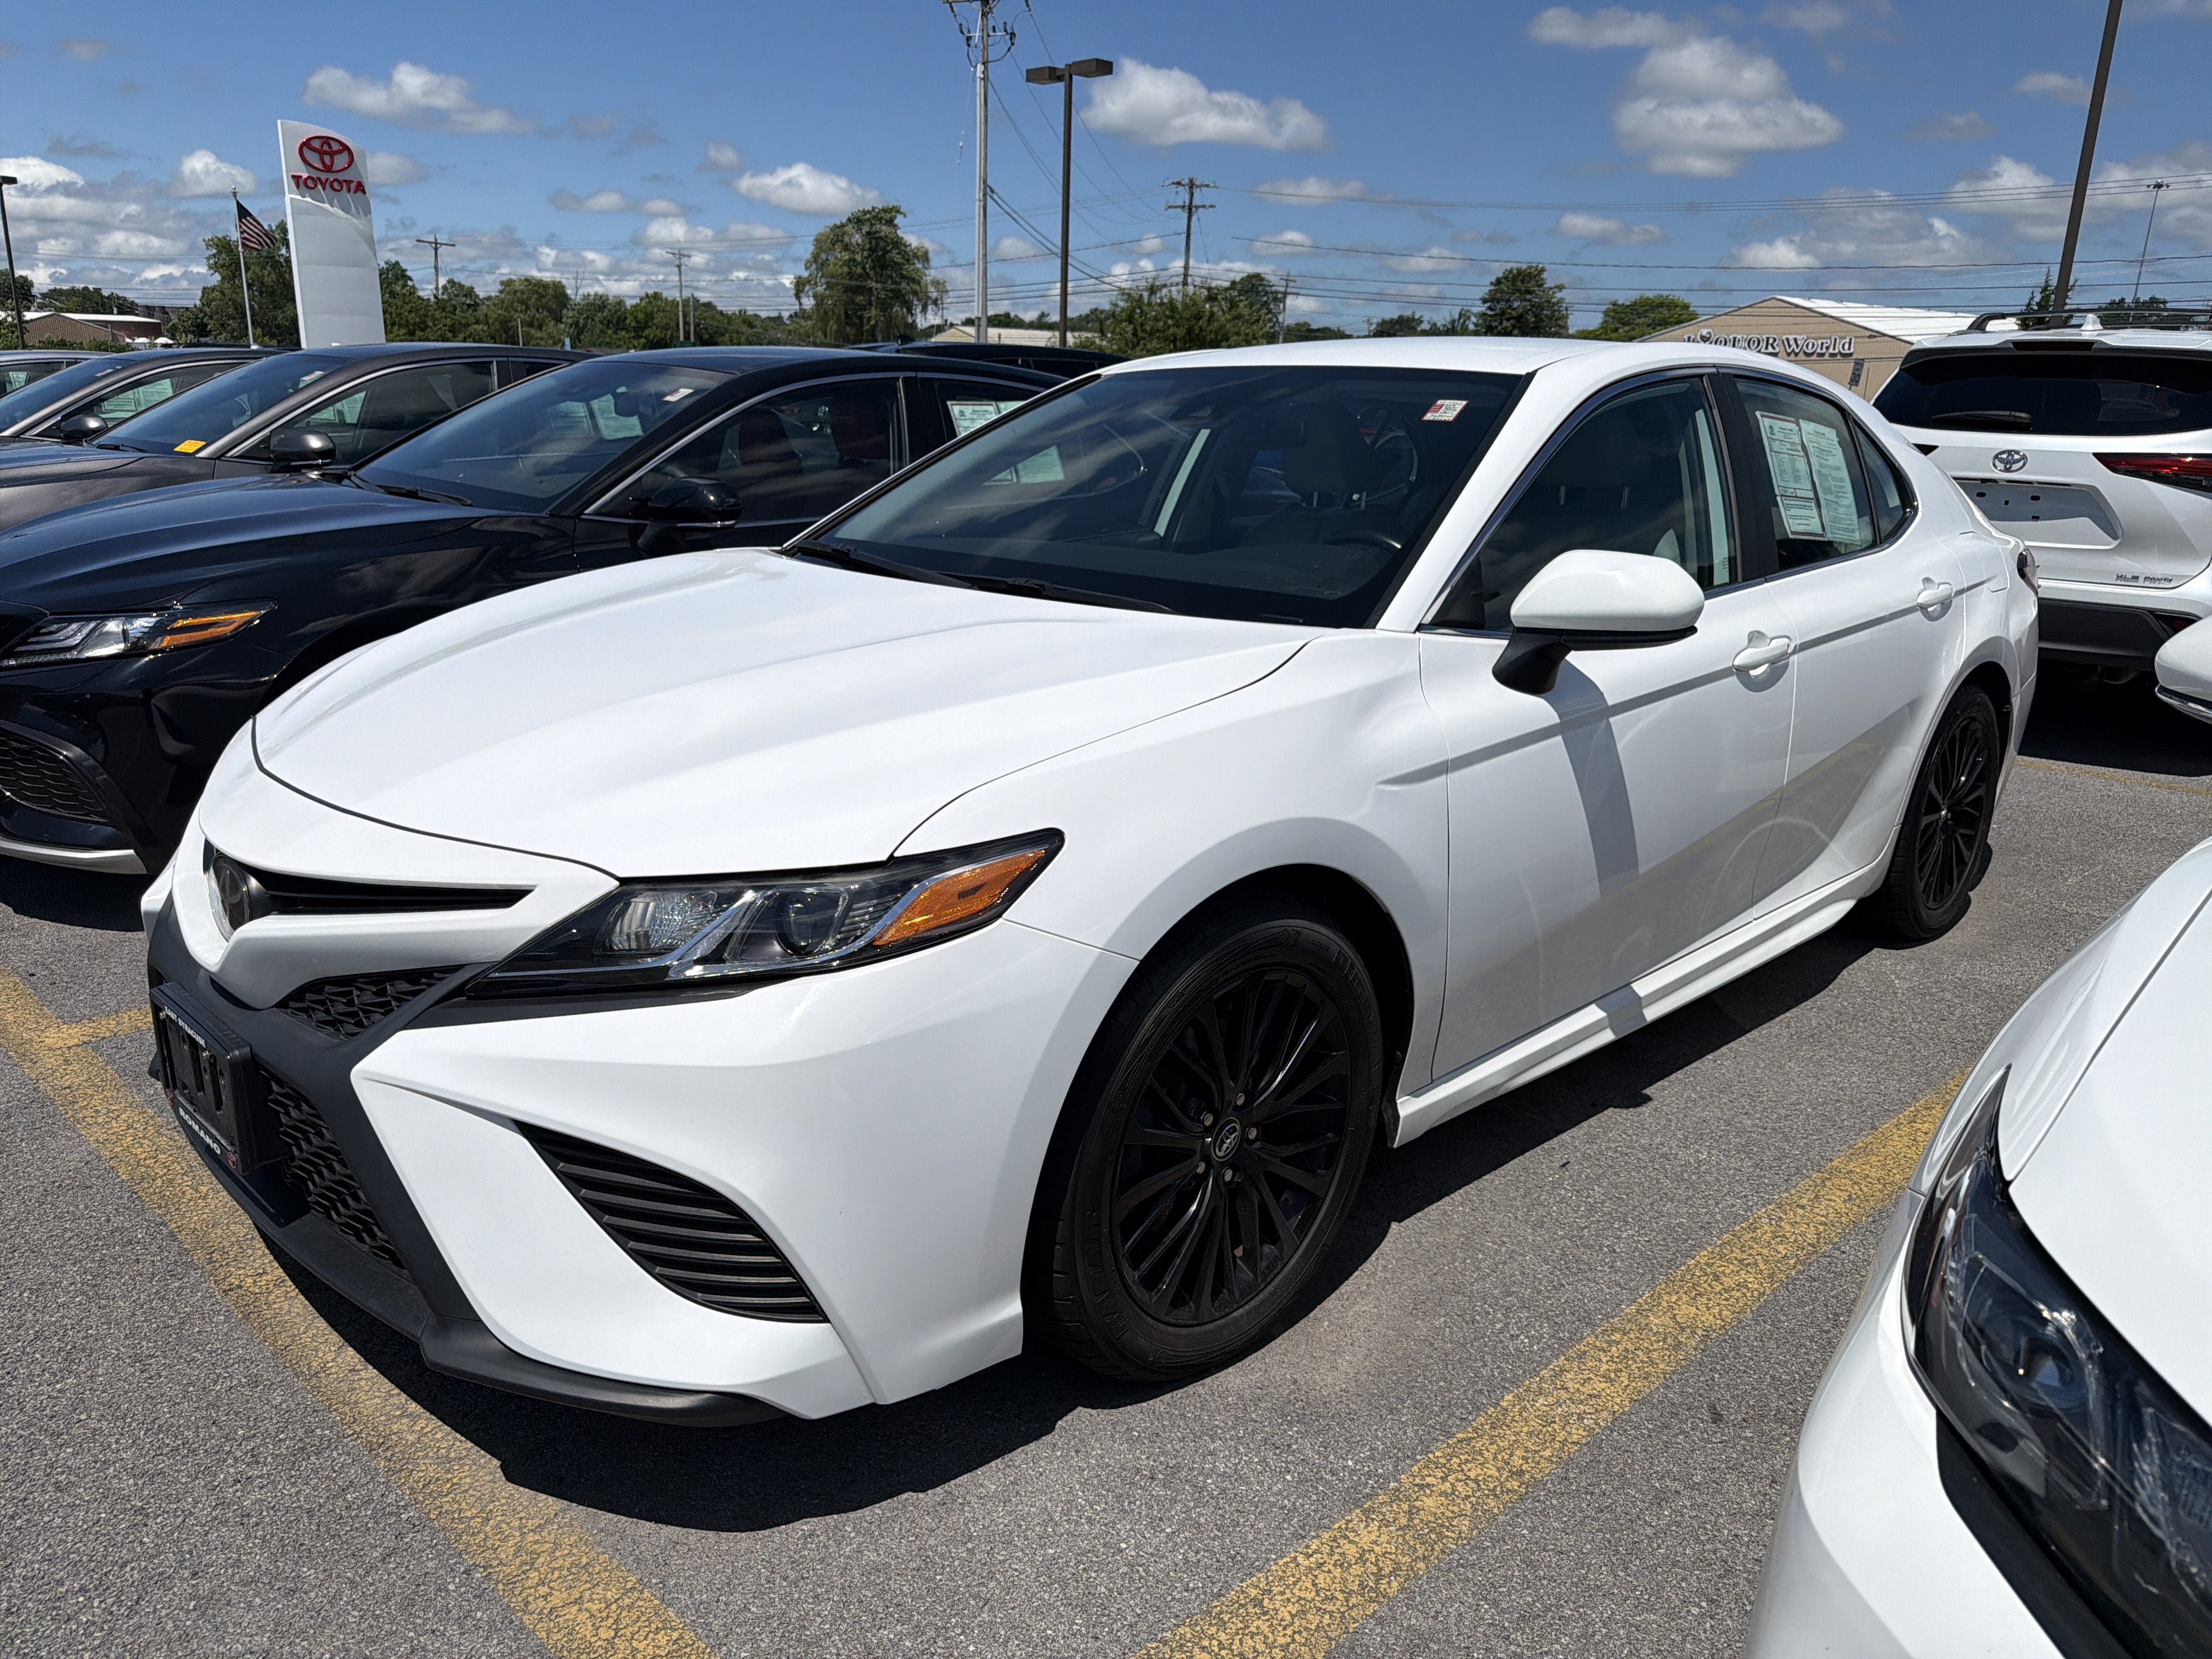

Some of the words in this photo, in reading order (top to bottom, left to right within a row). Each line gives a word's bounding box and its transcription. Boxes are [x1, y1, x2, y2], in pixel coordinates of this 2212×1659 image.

[291, 174, 367, 195] TOYOTA
[1782, 335, 1854, 354] World
[165, 1005, 177, 1023] EAST
[178, 1017, 206, 1048] SYRACUSE
[179, 1107, 221, 1155] ROMANO
